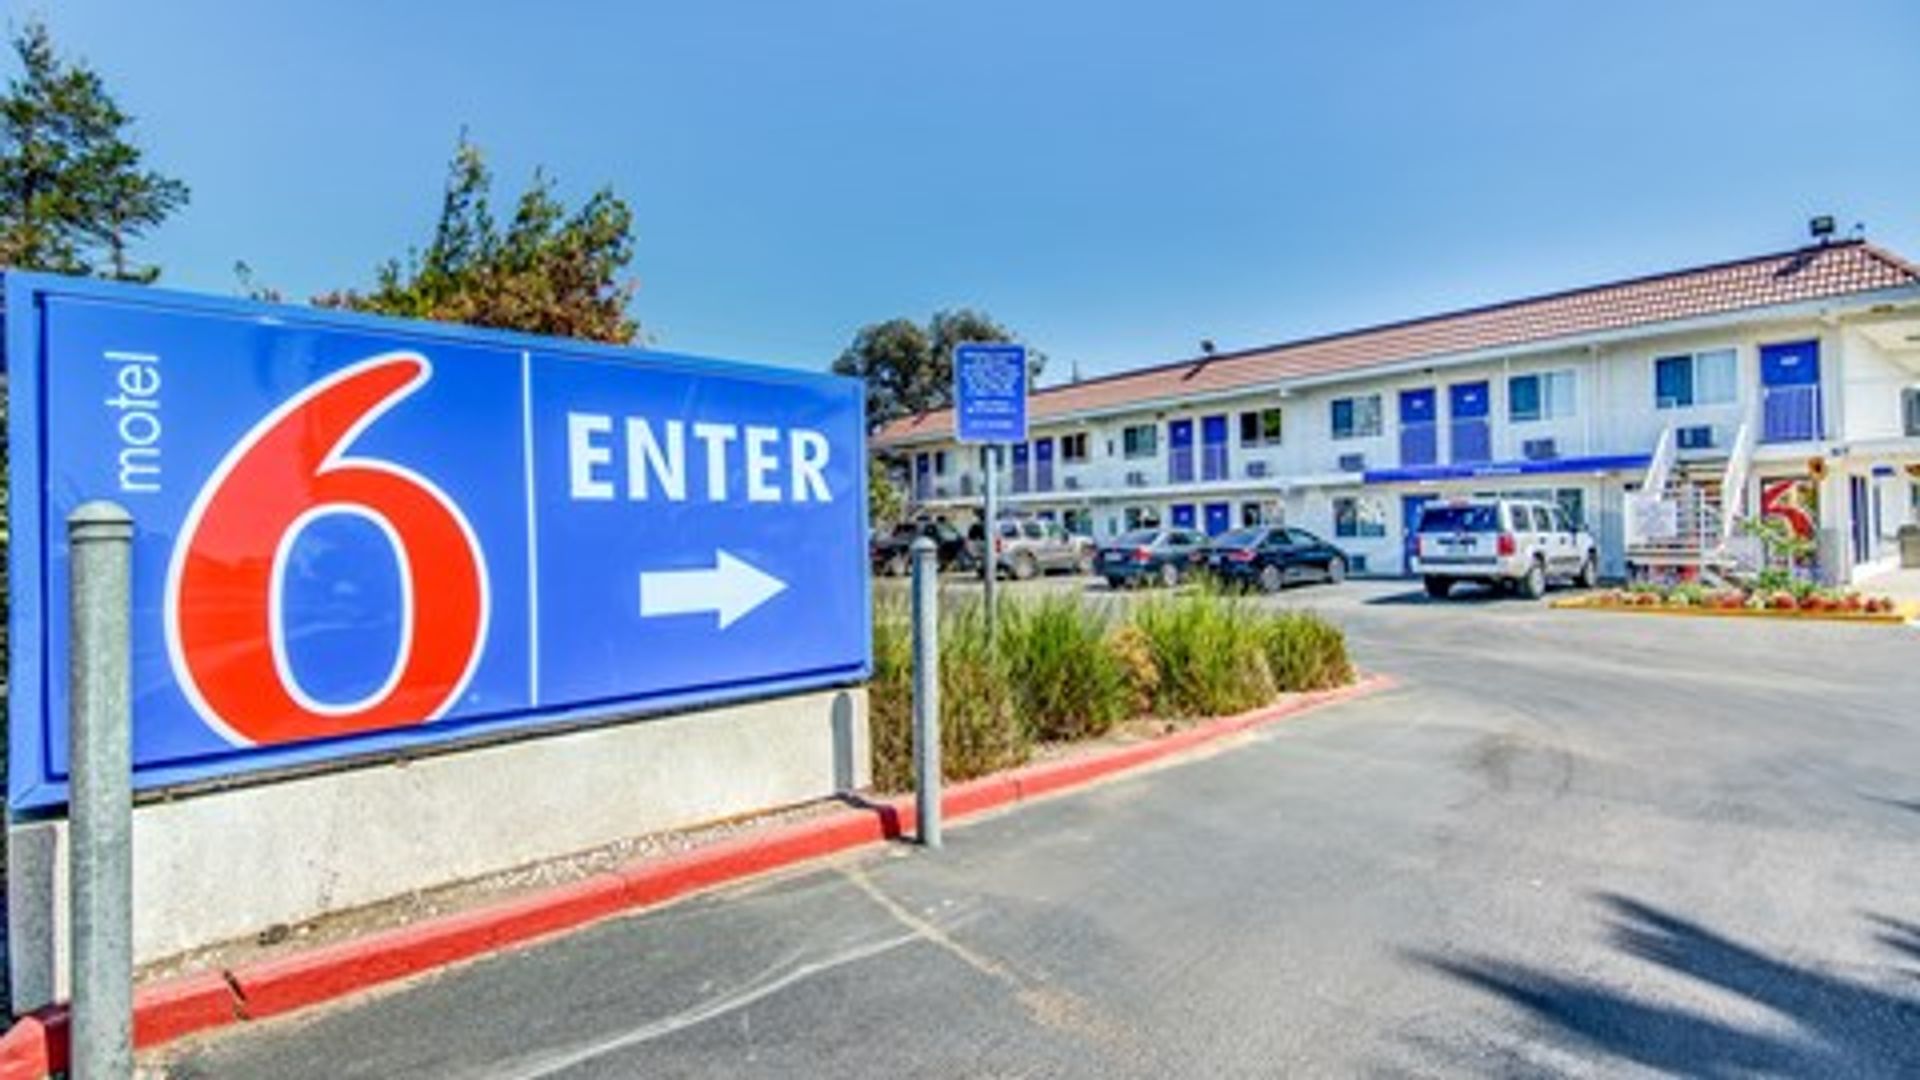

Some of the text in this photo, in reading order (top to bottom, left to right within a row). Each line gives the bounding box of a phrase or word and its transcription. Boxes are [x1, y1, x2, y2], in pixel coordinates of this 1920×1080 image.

[103, 351, 161, 491] motel
[567, 411, 833, 502] ENTER
[164, 351, 490, 747] 6
